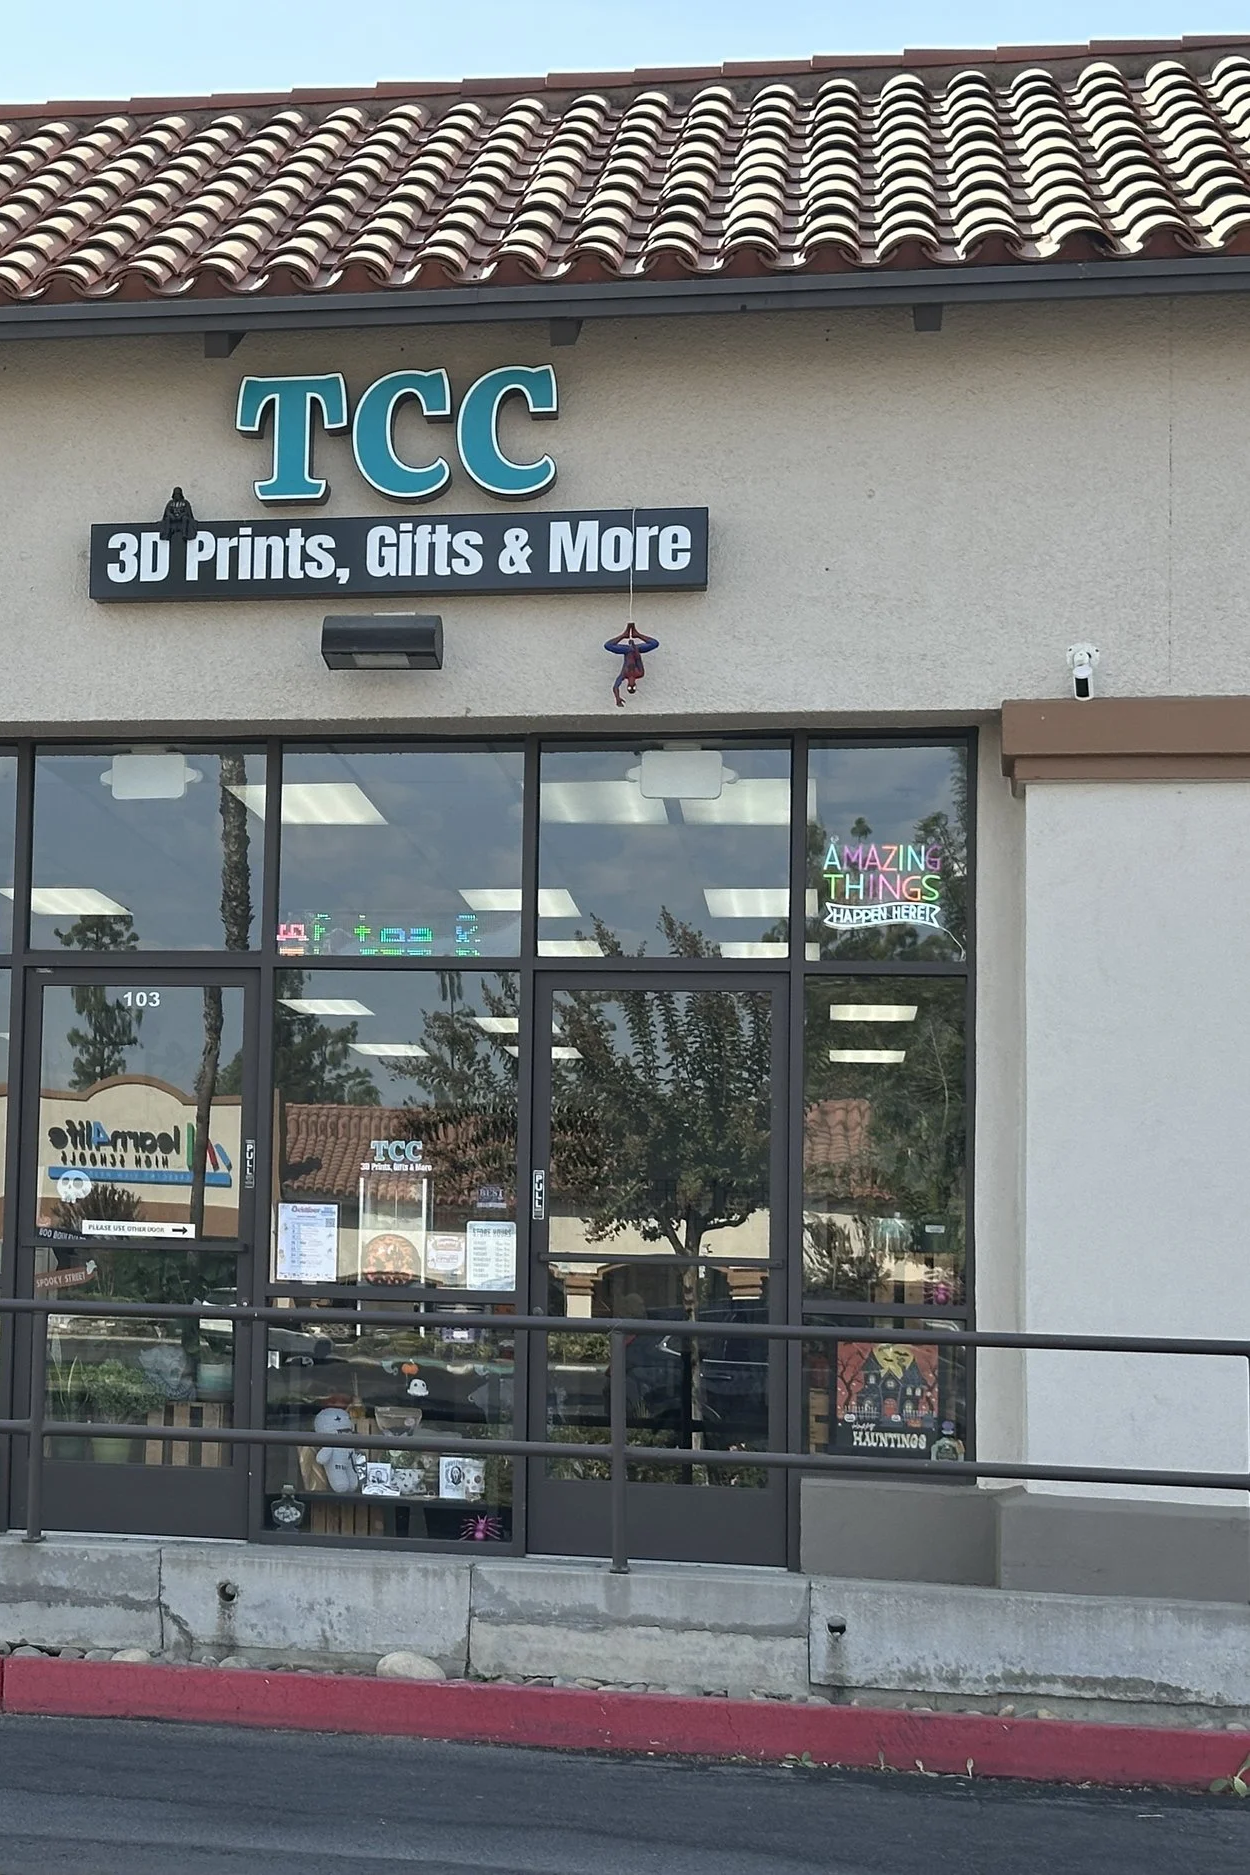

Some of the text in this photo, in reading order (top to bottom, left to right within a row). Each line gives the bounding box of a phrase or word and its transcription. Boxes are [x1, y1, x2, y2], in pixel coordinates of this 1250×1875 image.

[235, 364, 559, 505] TCC
[107, 519, 691, 585] 3D Prints, Gifts & More
[823, 843, 942, 871] AMAZING
[823, 873, 941, 902] THINGS
[833, 905, 930, 924] HAPPEN HERE!
[123, 992, 161, 1007] 103
[246, 1144, 254, 1175] PULL
[371, 1140, 423, 1162] TCC
[535, 1174, 543, 1208] PULL
[36, 1271, 86, 1288] SPOOKY STREET
[852, 1431, 927, 1450] HAUNTINGS
